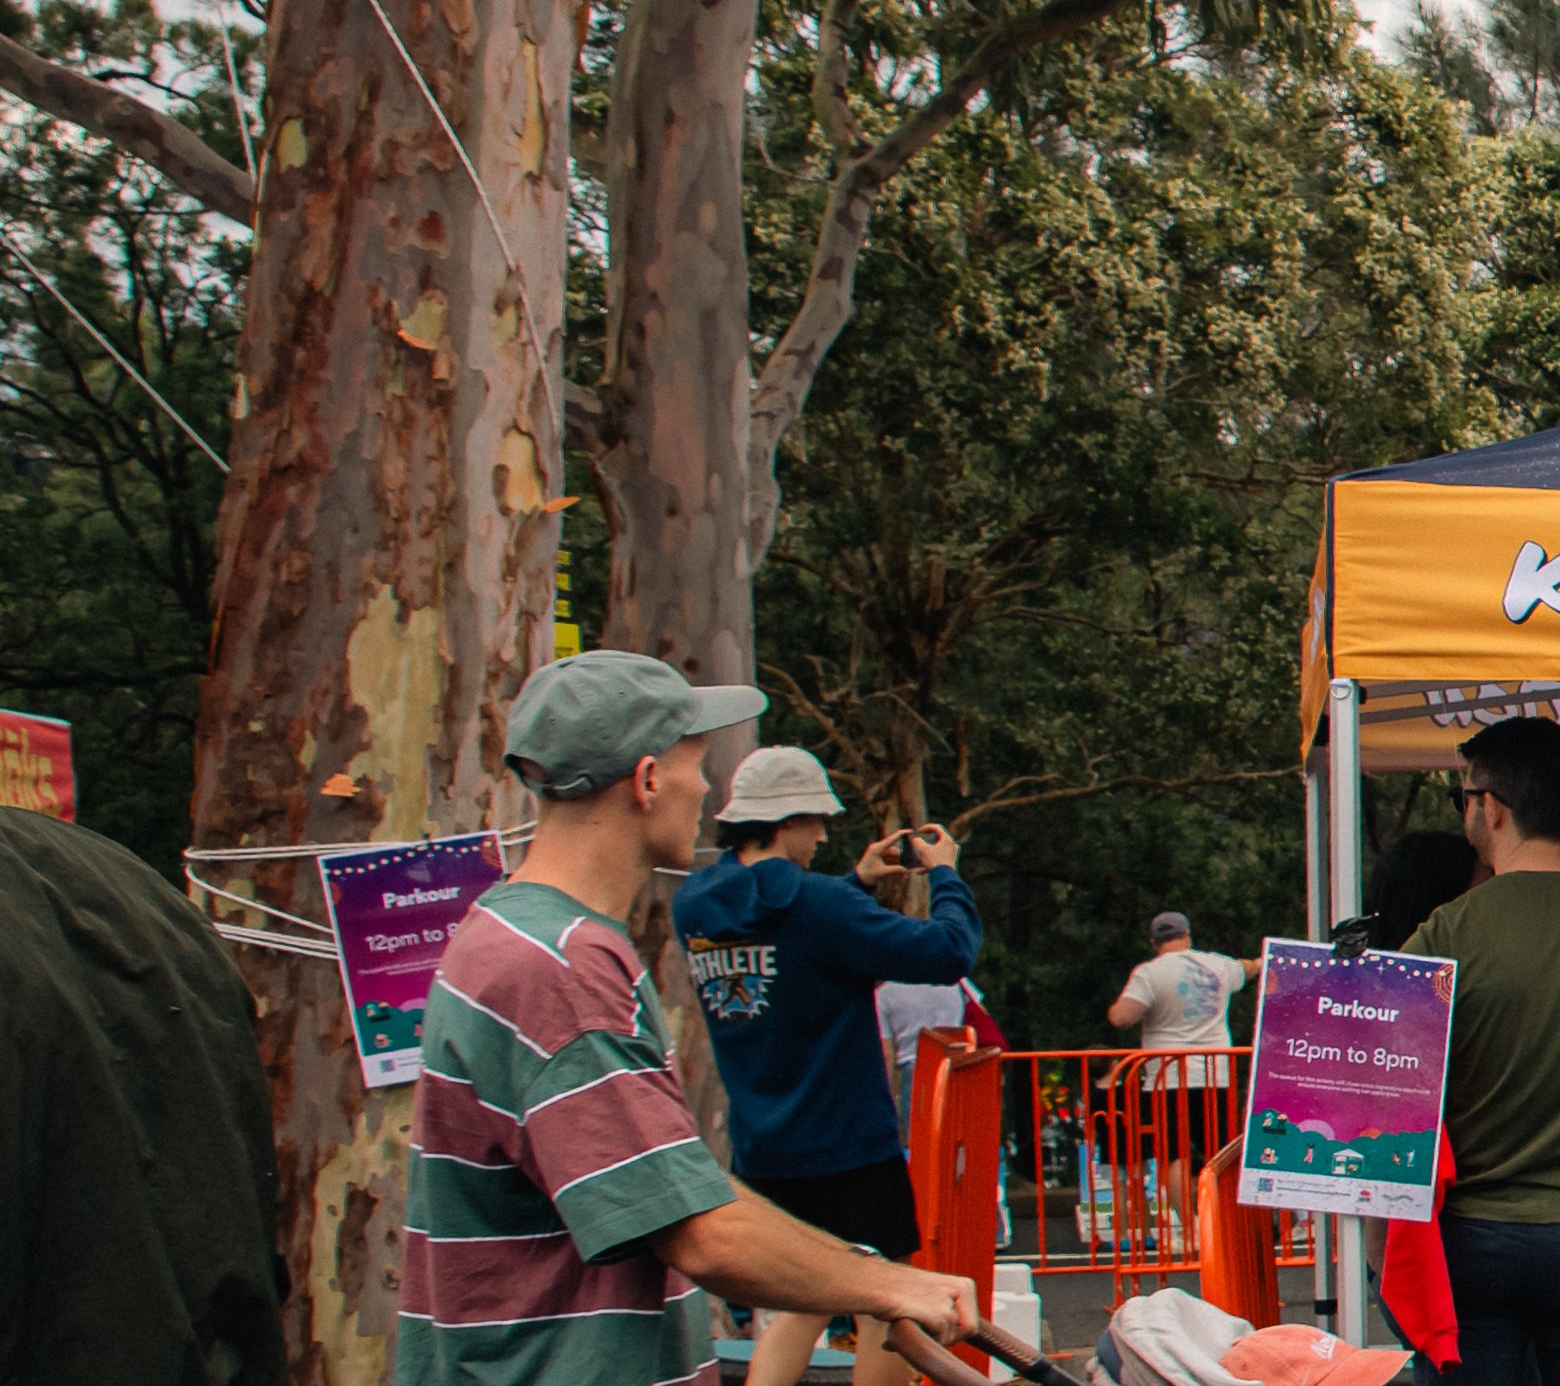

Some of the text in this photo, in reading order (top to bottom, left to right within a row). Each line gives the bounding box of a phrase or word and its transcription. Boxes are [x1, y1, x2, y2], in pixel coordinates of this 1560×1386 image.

[381, 886, 462, 910] Parkour
[365, 929, 421, 953] 12pm
[423, 926, 445, 943] to
[1317, 995, 1401, 1023] Parkour
[1286, 1037, 1421, 1072] 12pm to 8pm
